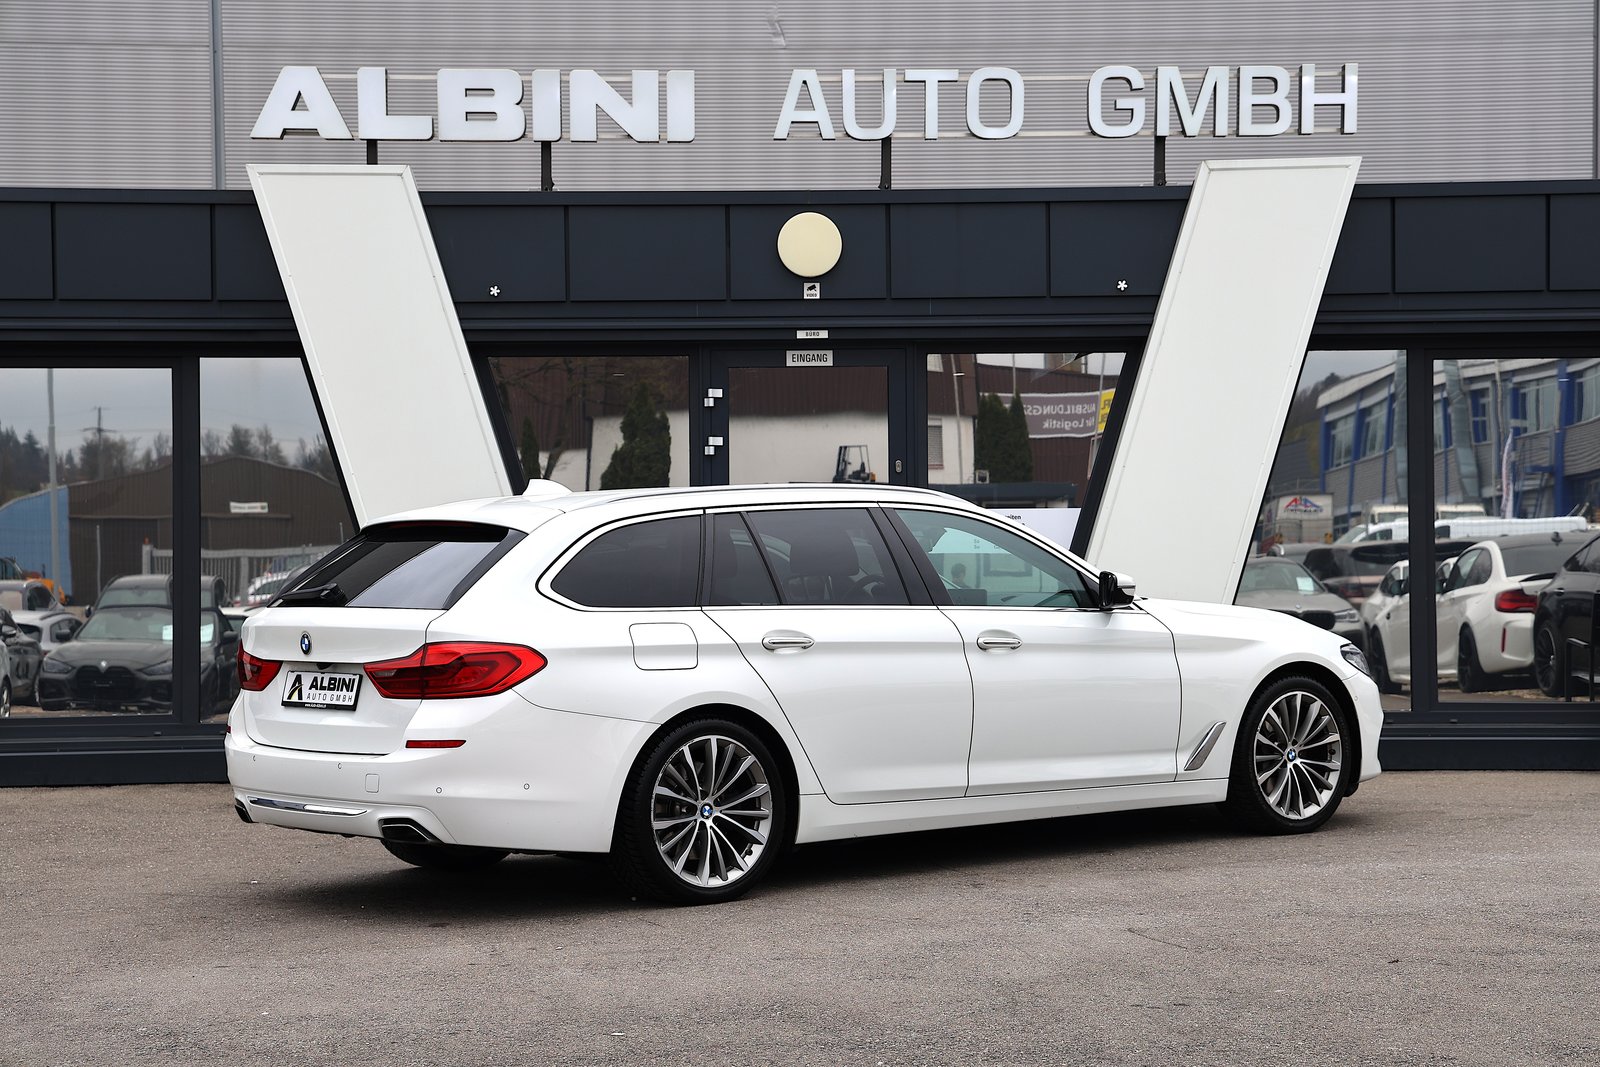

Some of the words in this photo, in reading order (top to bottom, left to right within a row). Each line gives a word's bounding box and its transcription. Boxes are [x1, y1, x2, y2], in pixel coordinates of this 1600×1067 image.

[249, 66, 695, 142] ALBINI
[773, 66, 1025, 141] AUTO
[1087, 63, 1359, 139] GMBH
[791, 353, 828, 363] EINGANG
[309, 676, 355, 692] ALBINI
[307, 693, 327, 701] AUTO
[330, 694, 353, 702] GMBH
